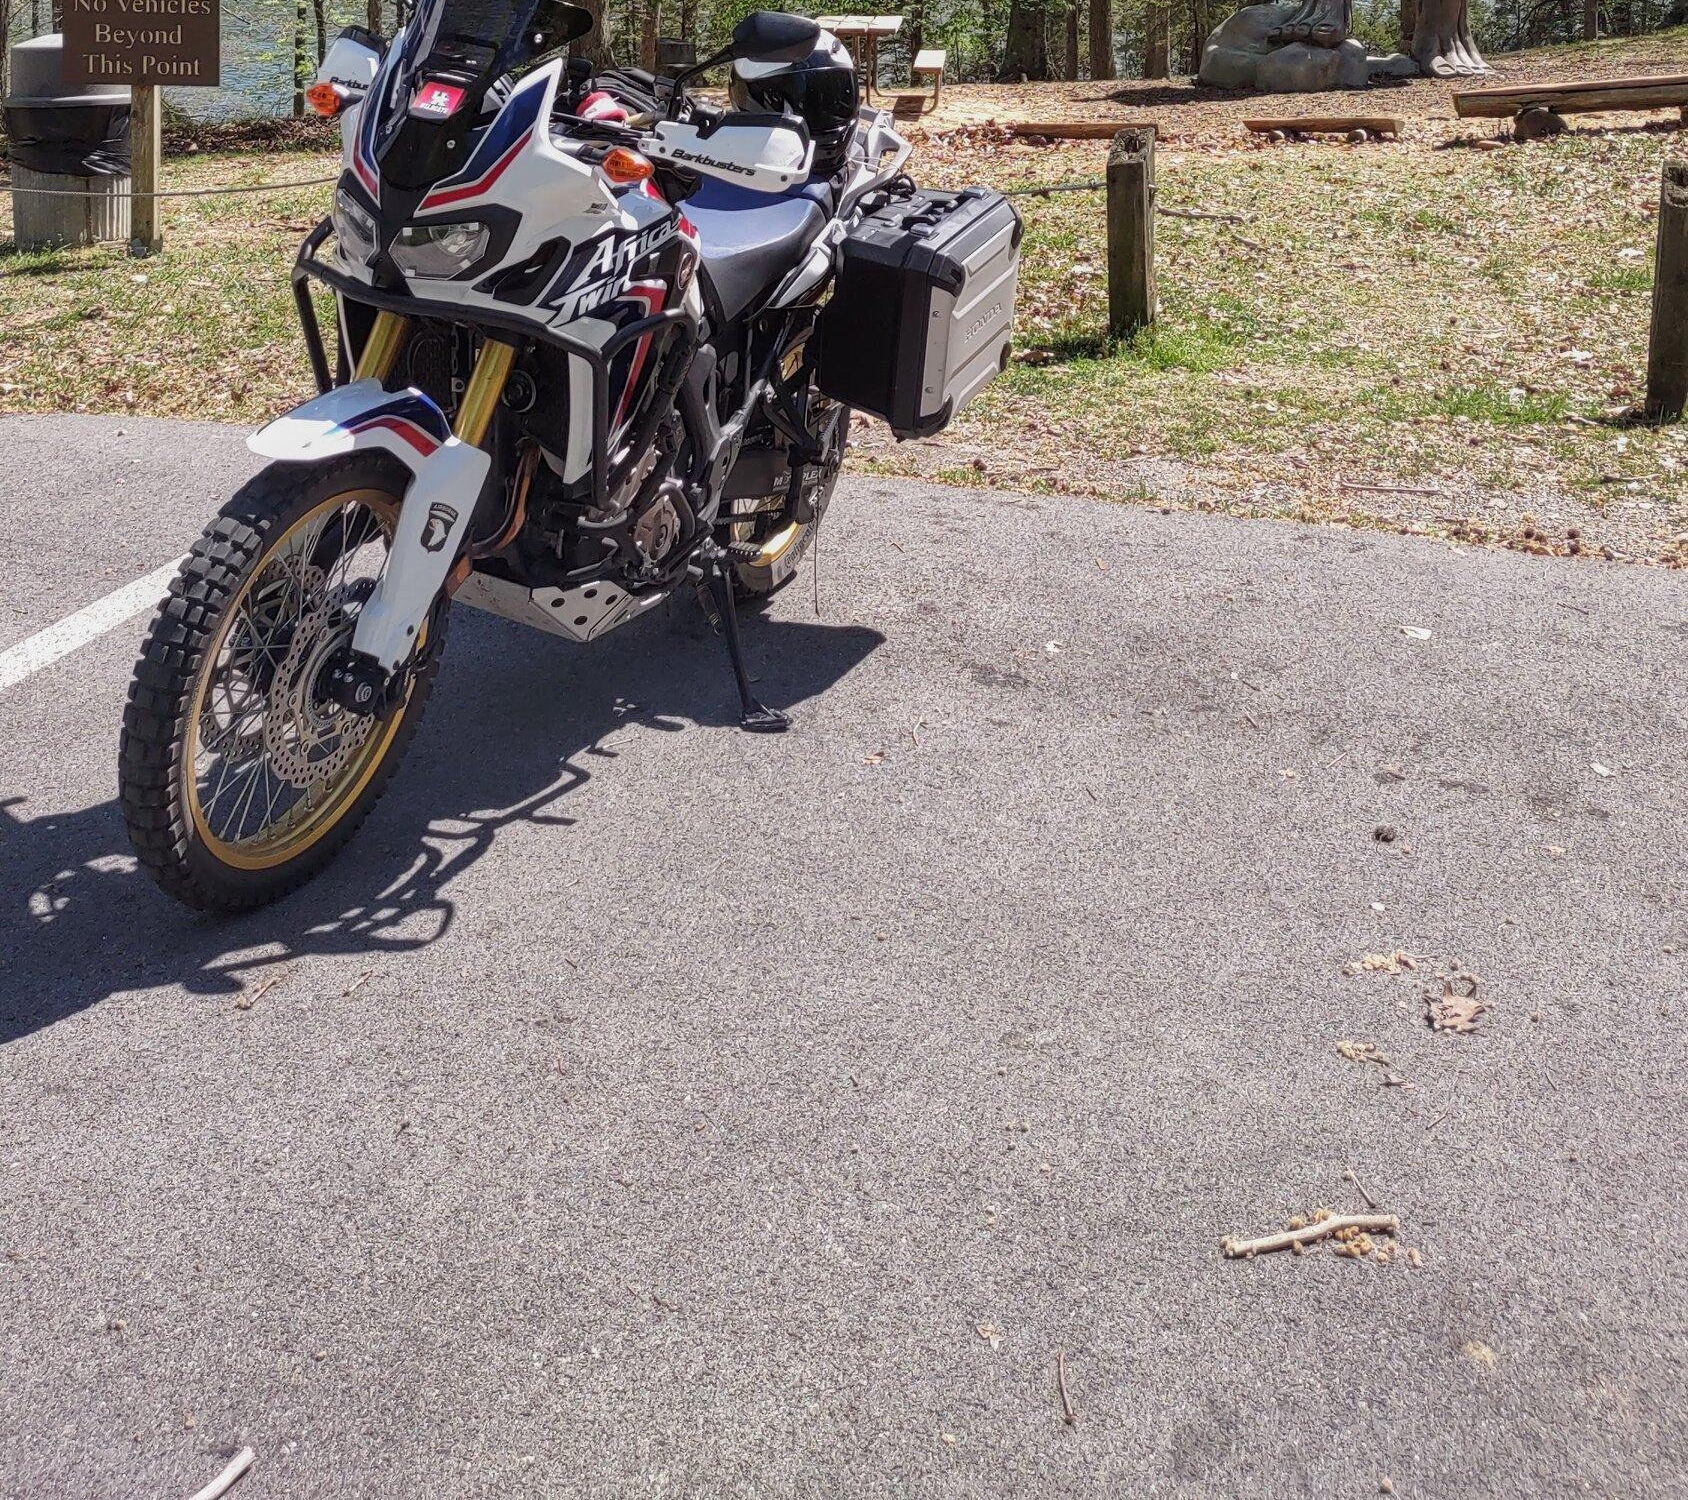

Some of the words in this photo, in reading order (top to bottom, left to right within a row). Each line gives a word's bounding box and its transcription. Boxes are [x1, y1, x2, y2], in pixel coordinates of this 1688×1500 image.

[95, 23, 182, 49] Beyond
[82, 54, 133, 75] This
[142, 55, 200, 76] Point
[671, 148, 757, 177] Barkbusters
[565, 213, 682, 294] Africa
[549, 276, 631, 328] Twin
